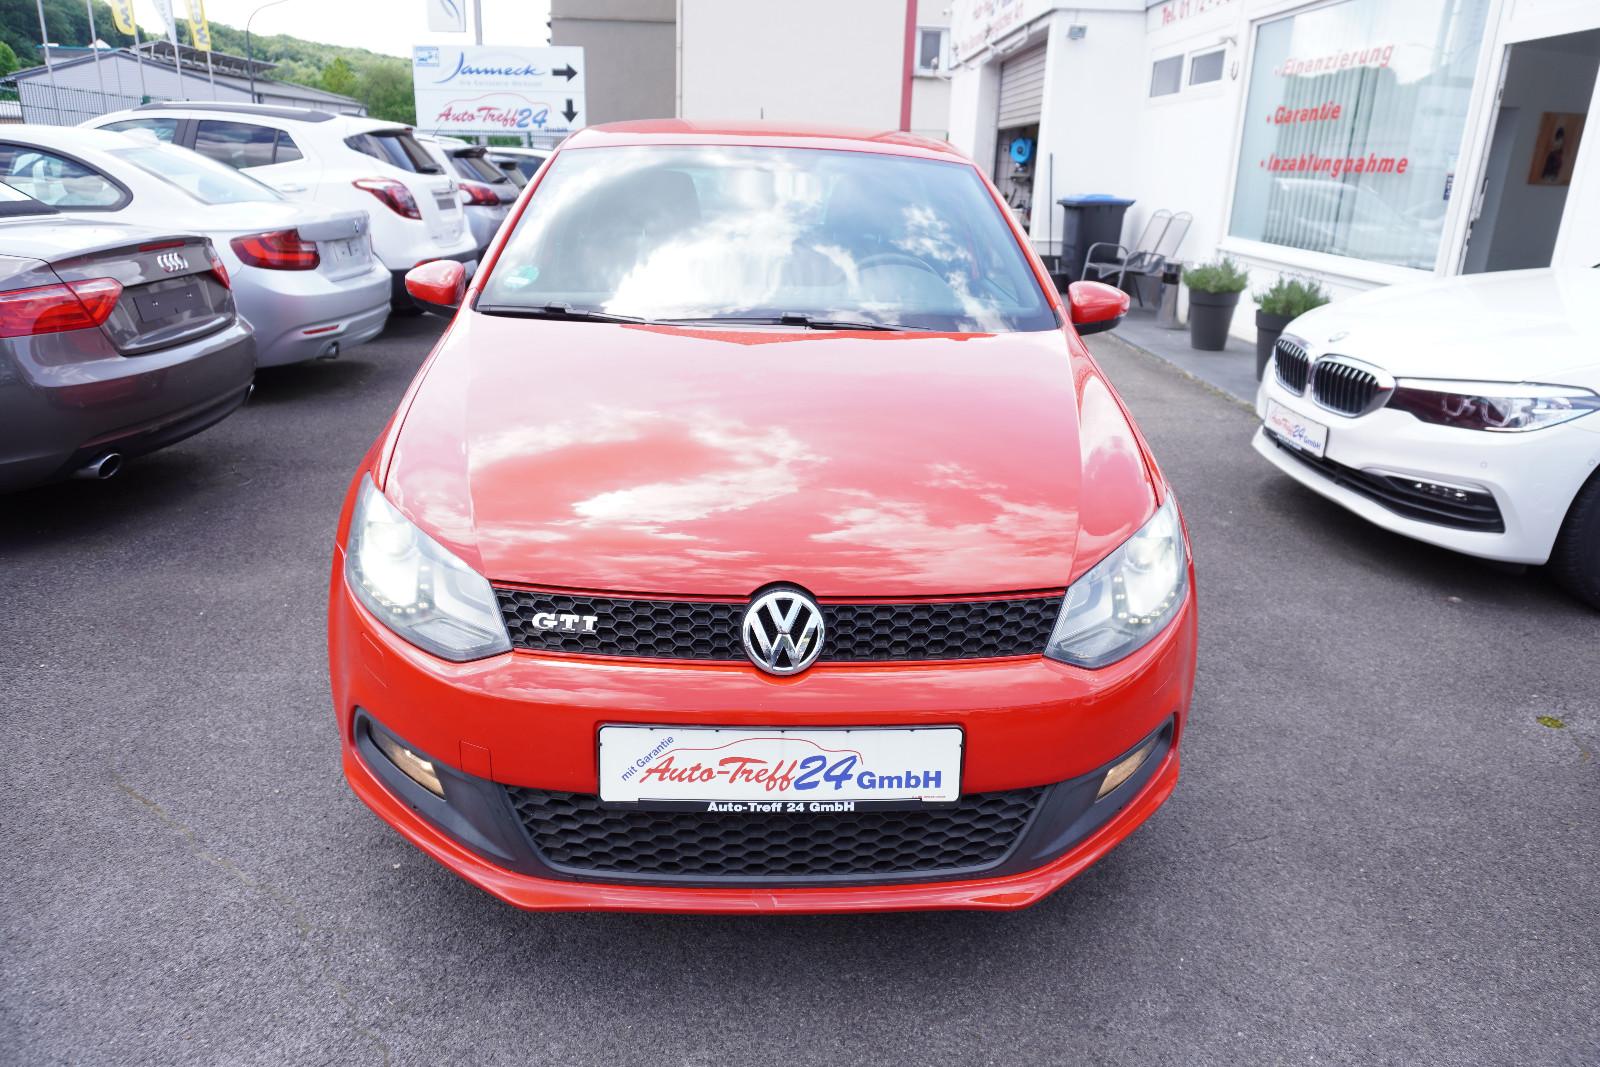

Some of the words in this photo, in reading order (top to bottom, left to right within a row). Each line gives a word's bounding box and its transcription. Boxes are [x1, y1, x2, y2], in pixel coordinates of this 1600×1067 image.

[1282, 44, 1394, 76] Finanzierung
[1273, 101, 1342, 125] Garantie
[1267, 152, 1409, 178] Inzahlungnahme
[531, 611, 598, 634] GTI
[621, 765, 637, 782] mit
[636, 735, 674, 767] Garantie
[857, 770, 942, 789] GmbH
[707, 802, 782, 812] Auto-Treff
[786, 802, 804, 812] 24
[809, 802, 855, 812] GmbH
